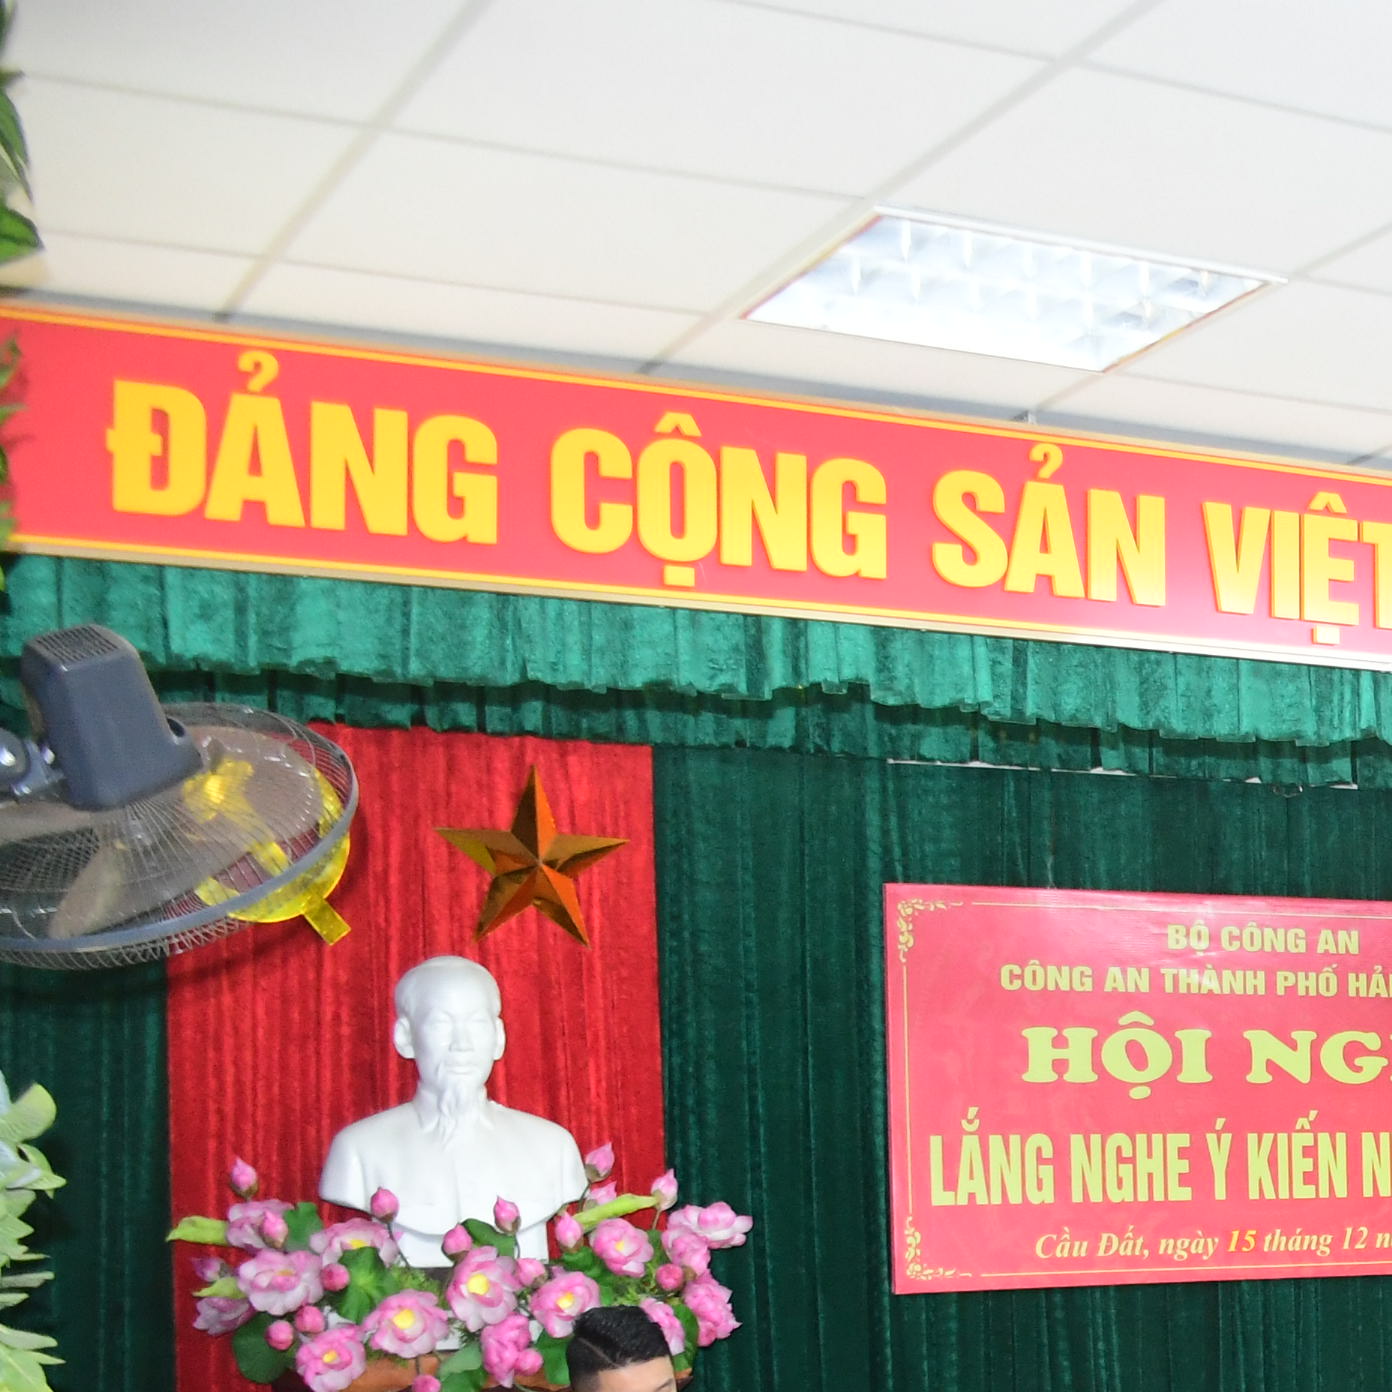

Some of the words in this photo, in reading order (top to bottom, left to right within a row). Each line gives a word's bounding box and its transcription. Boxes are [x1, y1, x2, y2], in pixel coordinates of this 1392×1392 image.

[106, 352, 498, 543] ĐẢNG
[551, 411, 887, 587] CỘNG
[932, 444, 1166, 607] SẢN
[1166, 918, 1211, 956] BỘ
[1220, 920, 1309, 953] CÔNG
[1316, 928, 1360, 954] AN
[1000, 958, 1095, 992] CÔNG
[1103, 965, 1152, 994] AN
[1160, 963, 1267, 995] THÀNH
[1275, 963, 1338, 997] PHỐ
[1020, 1009, 1213, 1099] HỘI
[929, 1106, 1056, 1207] LẮNG
[1069, 1132, 1192, 1203] NGHE
[1205, 1117, 1232, 1200] Ý
[1247, 1110, 1348, 1200] KIẾN
[1035, 1226, 1089, 1259] Cầu
[1096, 1225, 1150, 1259] Đất,
[1159, 1230, 1220, 1261] ngày
[1228, 1230, 1256, 1251] 15
[1263, 1228, 1333, 1256] tháng
[1343, 1226, 1368, 1250] 12
